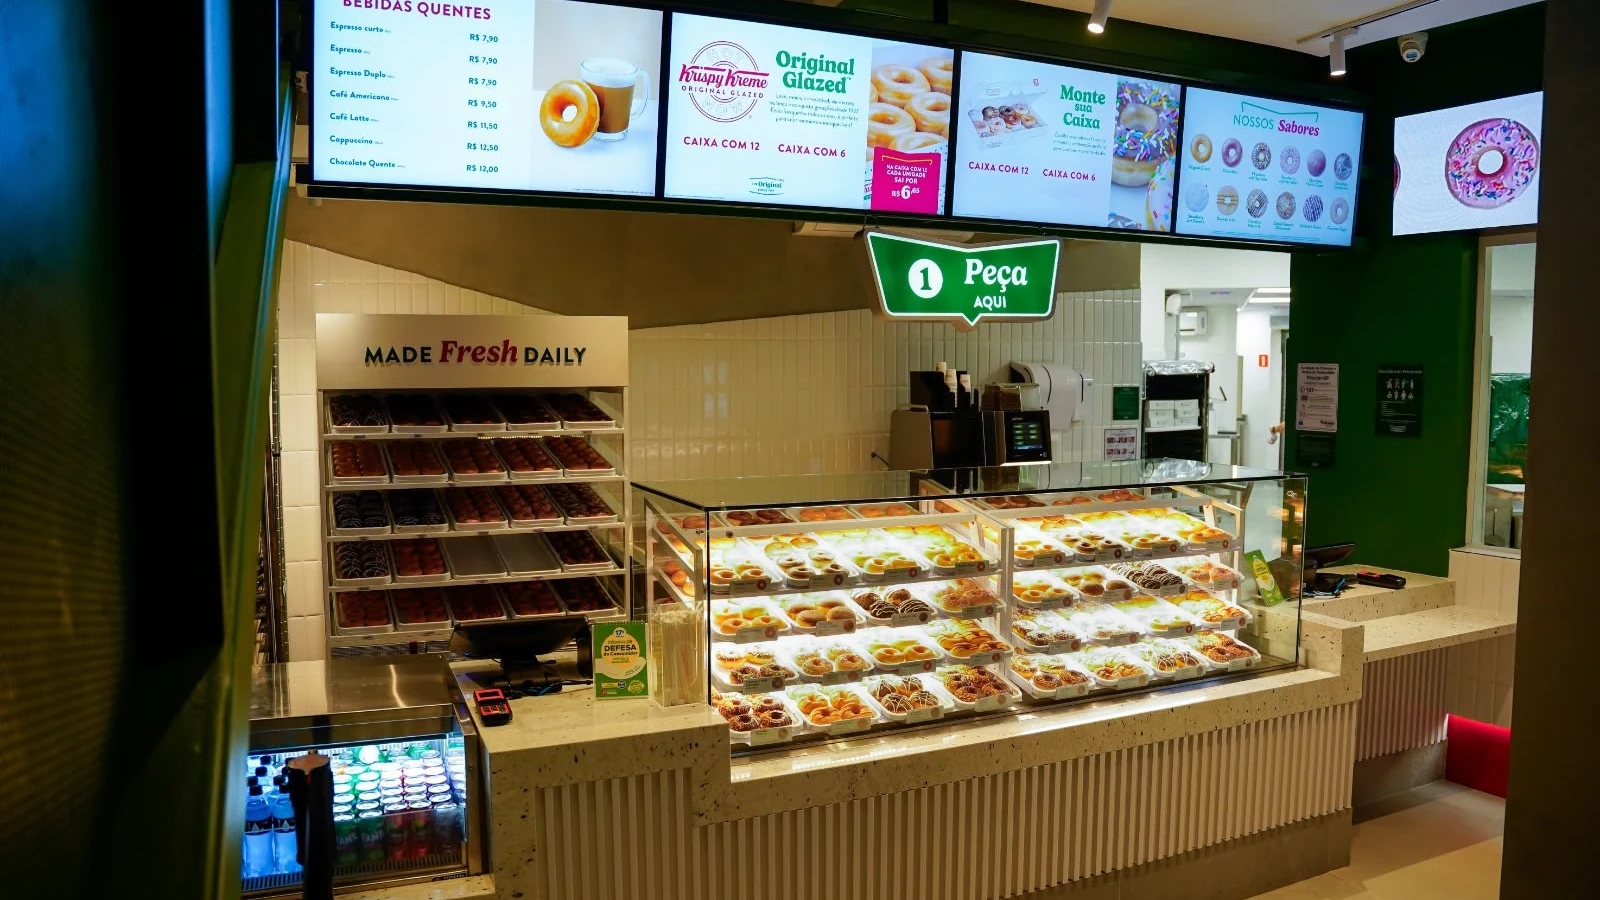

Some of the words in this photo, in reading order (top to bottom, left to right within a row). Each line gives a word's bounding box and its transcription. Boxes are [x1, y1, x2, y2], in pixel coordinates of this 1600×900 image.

[417, 2, 491, 20] QUENTES
[330, 21, 362, 31] Espresso
[364, 25, 384, 33] curto
[469, 34, 480, 42] R$
[482, 34, 499, 43] 7,90
[330, 44, 362, 54] Espresso
[481, 56, 498, 65] 7,90
[776, 50, 855, 75] Original
[330, 67, 362, 77] Espresso
[364, 70, 386, 79] Duplo
[678, 64, 727, 88] Krispy
[725, 69, 770, 89] Kreme
[468, 77, 479, 85] R$
[481, 78, 497, 87] 7,90
[330, 90, 348, 98] Café
[350, 92, 390, 101] Americano
[681, 85, 726, 95] ORIGINAL
[730, 89, 764, 99] GLAZED
[1060, 84, 1106, 105] Monte
[468, 99, 478, 107] R$
[480, 100, 497, 109] 9,50
[1074, 103, 1092, 113] sua
[330, 112, 348, 121] Café
[350, 114, 370, 122] Latte
[1063, 112, 1100, 130] Caixa
[467, 121, 477, 129] R$
[480, 122, 498, 130] 11,50
[1233, 114, 1274, 129] NOSSOS
[1277, 119, 1320, 136] Sabores
[329, 135, 373, 145] Cappuccino
[683, 136, 718, 147] CAIXA
[721, 139, 747, 149] COM
[750, 142, 760, 150] 12
[480, 144, 499, 152] 12,50
[778, 143, 810, 154] CAIXA
[813, 147, 838, 157] COM
[840, 149, 846, 157] 6
[329, 157, 367, 167] Chocolate
[368, 160, 396, 168] Quente
[968, 161, 996, 172] CAIXA
[998, 164, 1019, 174] COM
[1021, 166, 1029, 175] 12
[479, 165, 499, 173] 12,00
[1042, 169, 1068, 179] CAIXA
[1070, 171, 1089, 181] COM
[1091, 173, 1096, 181] 6
[919, 266, 932, 291] 1
[964, 258, 1028, 293] Peça
[974, 295, 1007, 311] AQUI
[364, 346, 432, 364] MADE
[439, 339, 518, 363] Fresh
[524, 347, 587, 363] DAILY
